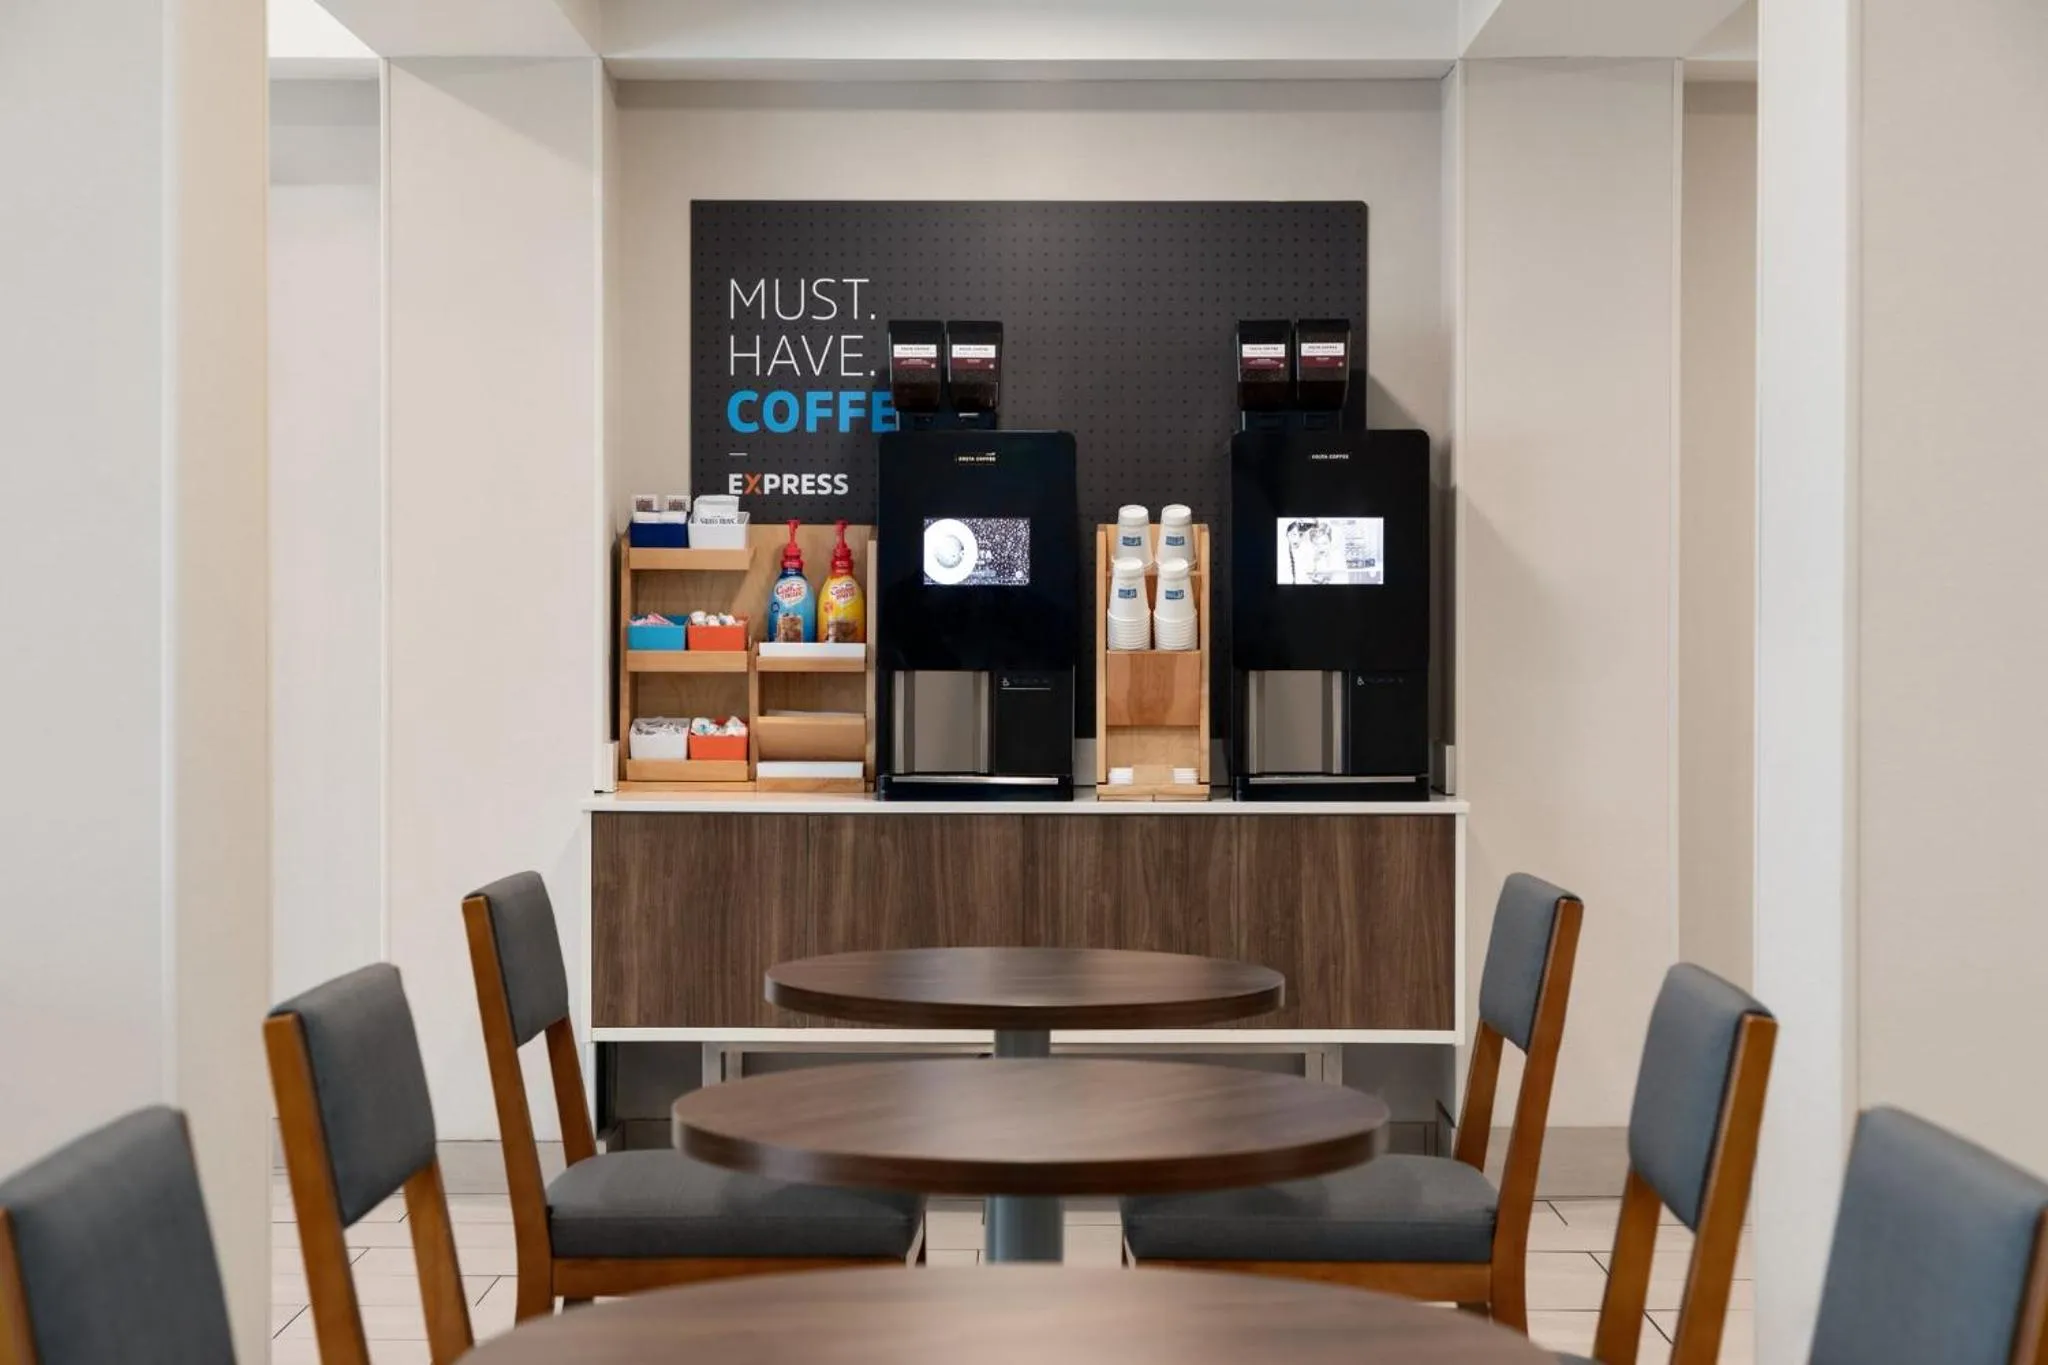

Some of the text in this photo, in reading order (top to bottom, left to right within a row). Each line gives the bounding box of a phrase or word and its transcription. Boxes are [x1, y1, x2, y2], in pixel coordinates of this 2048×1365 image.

[729, 277, 877, 321] MUST.
[729, 334, 877, 377] HAVE.
[726, 389, 898, 433] COFFE
[728, 473, 850, 495] EXPRESS
